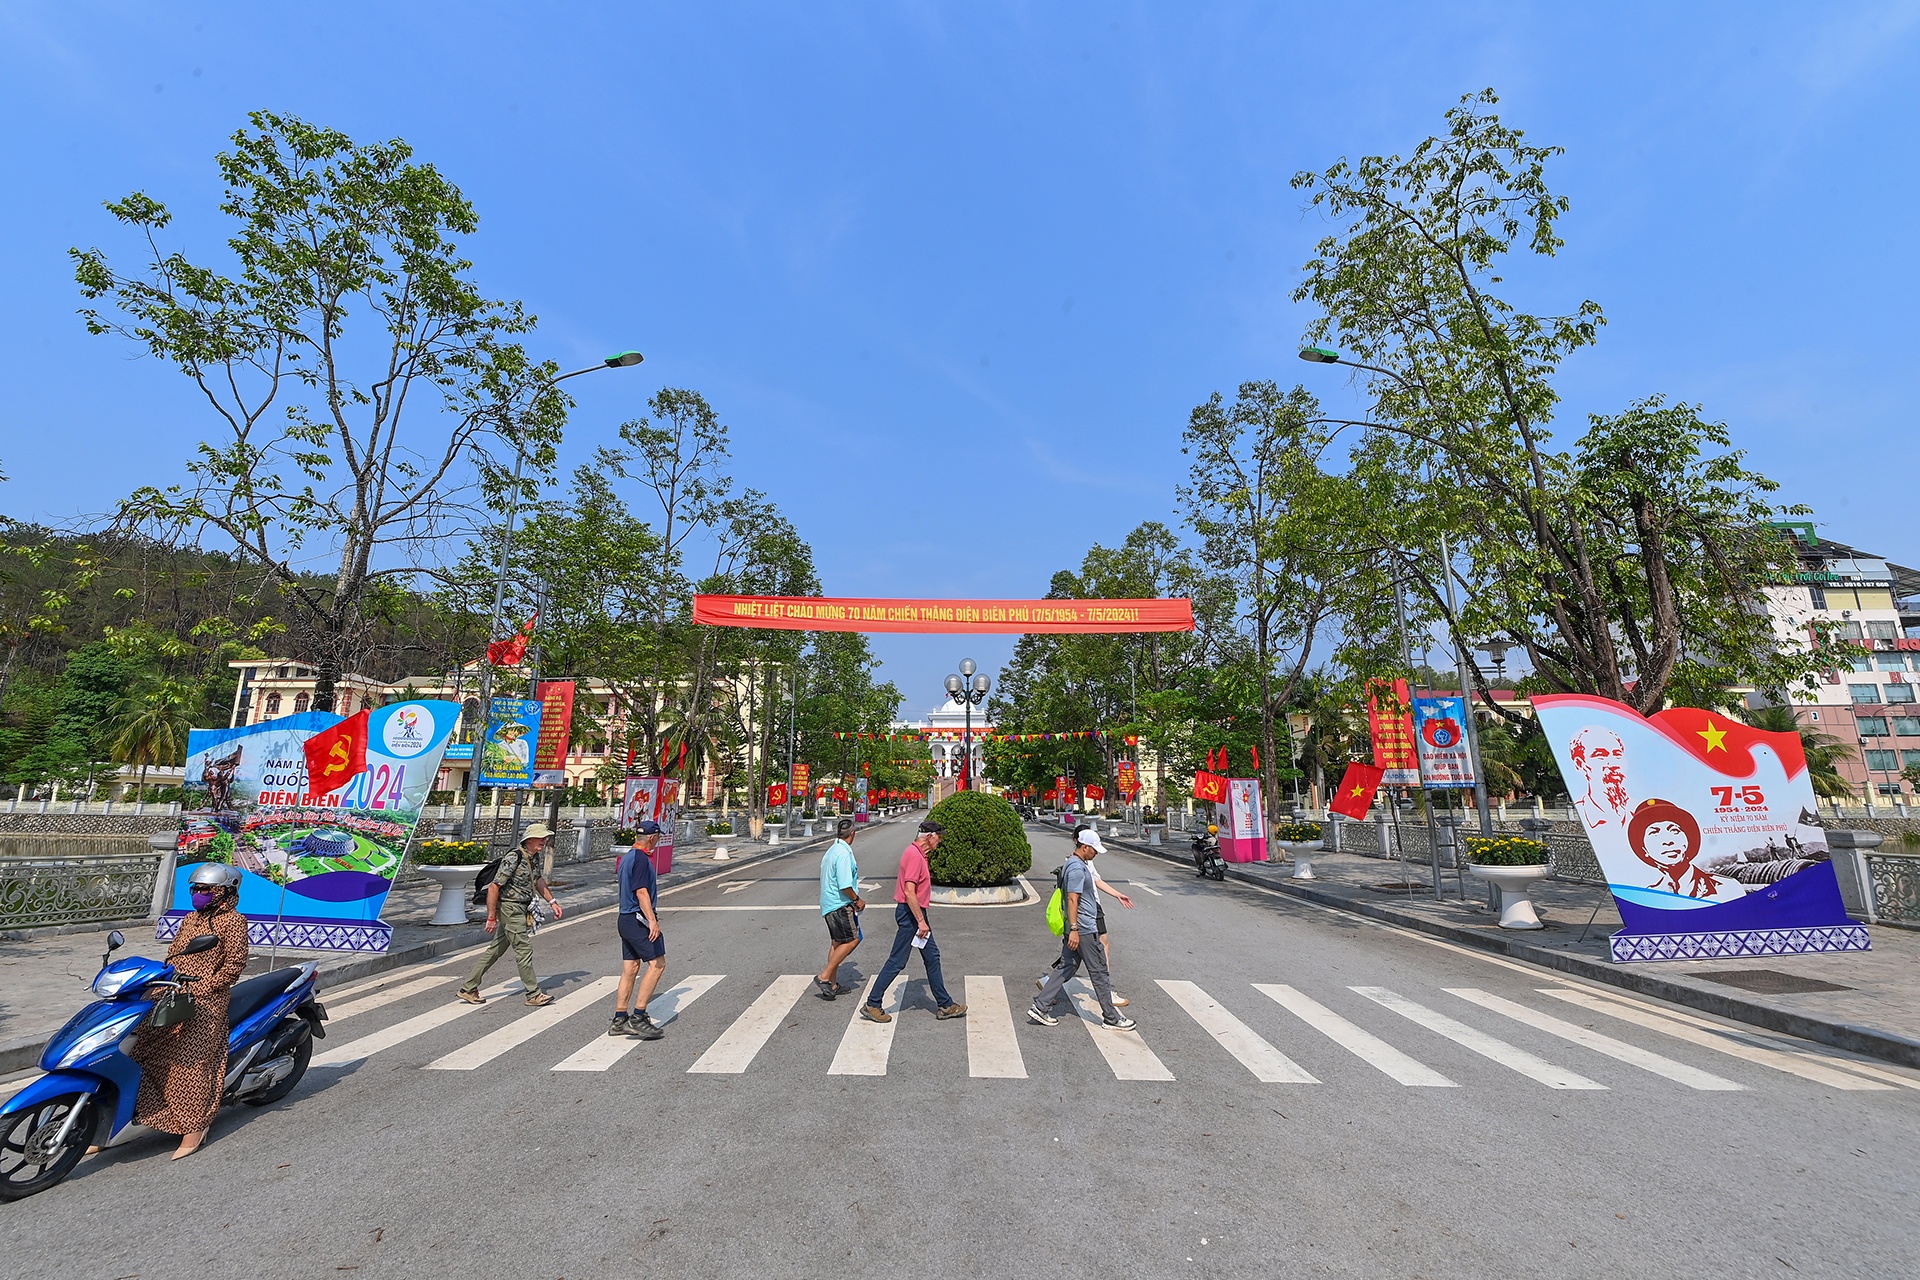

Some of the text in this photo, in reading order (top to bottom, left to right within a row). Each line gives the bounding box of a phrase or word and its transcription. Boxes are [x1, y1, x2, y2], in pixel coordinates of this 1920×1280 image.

[734, 600, 762, 618] NHIỆT
[765, 602, 785, 618] LIỆT
[787, 602, 813, 618] CHÀO
[816, 603, 846, 619] MỪNG
[848, 606, 860, 620] 70
[863, 604, 886, 620] NĂM
[888, 604, 918, 621] CHIẾN
[920, 604, 953, 621] THẮNG
[956, 605, 980, 623] ĐIỆN
[982, 605, 1006, 622] BIÊN
[1009, 605, 1029, 622] PHỦ
[1032, 608, 1077, 622] (7/5/1954
[1087, 608, 1139, 622] 7/5/2024)!
[1435, 751, 1448, 759] HIỂM
[266, 758, 293, 769] NĂM
[263, 771, 309, 786] QUỐC
[259, 790, 298, 808] ĐIỆN
[340, 764, 405, 810] 2024
[1710, 785, 1765, 806] 7-5
[1720, 814, 1729, 822] KỶ
[1730, 814, 1745, 823] NIỆM
[1703, 824, 1723, 834] CHIẾN
[1724, 824, 1746, 833] THẮNG
[1747, 824, 1760, 833] ĐIỆN
[88, 1054, 113, 1067] HONDA
